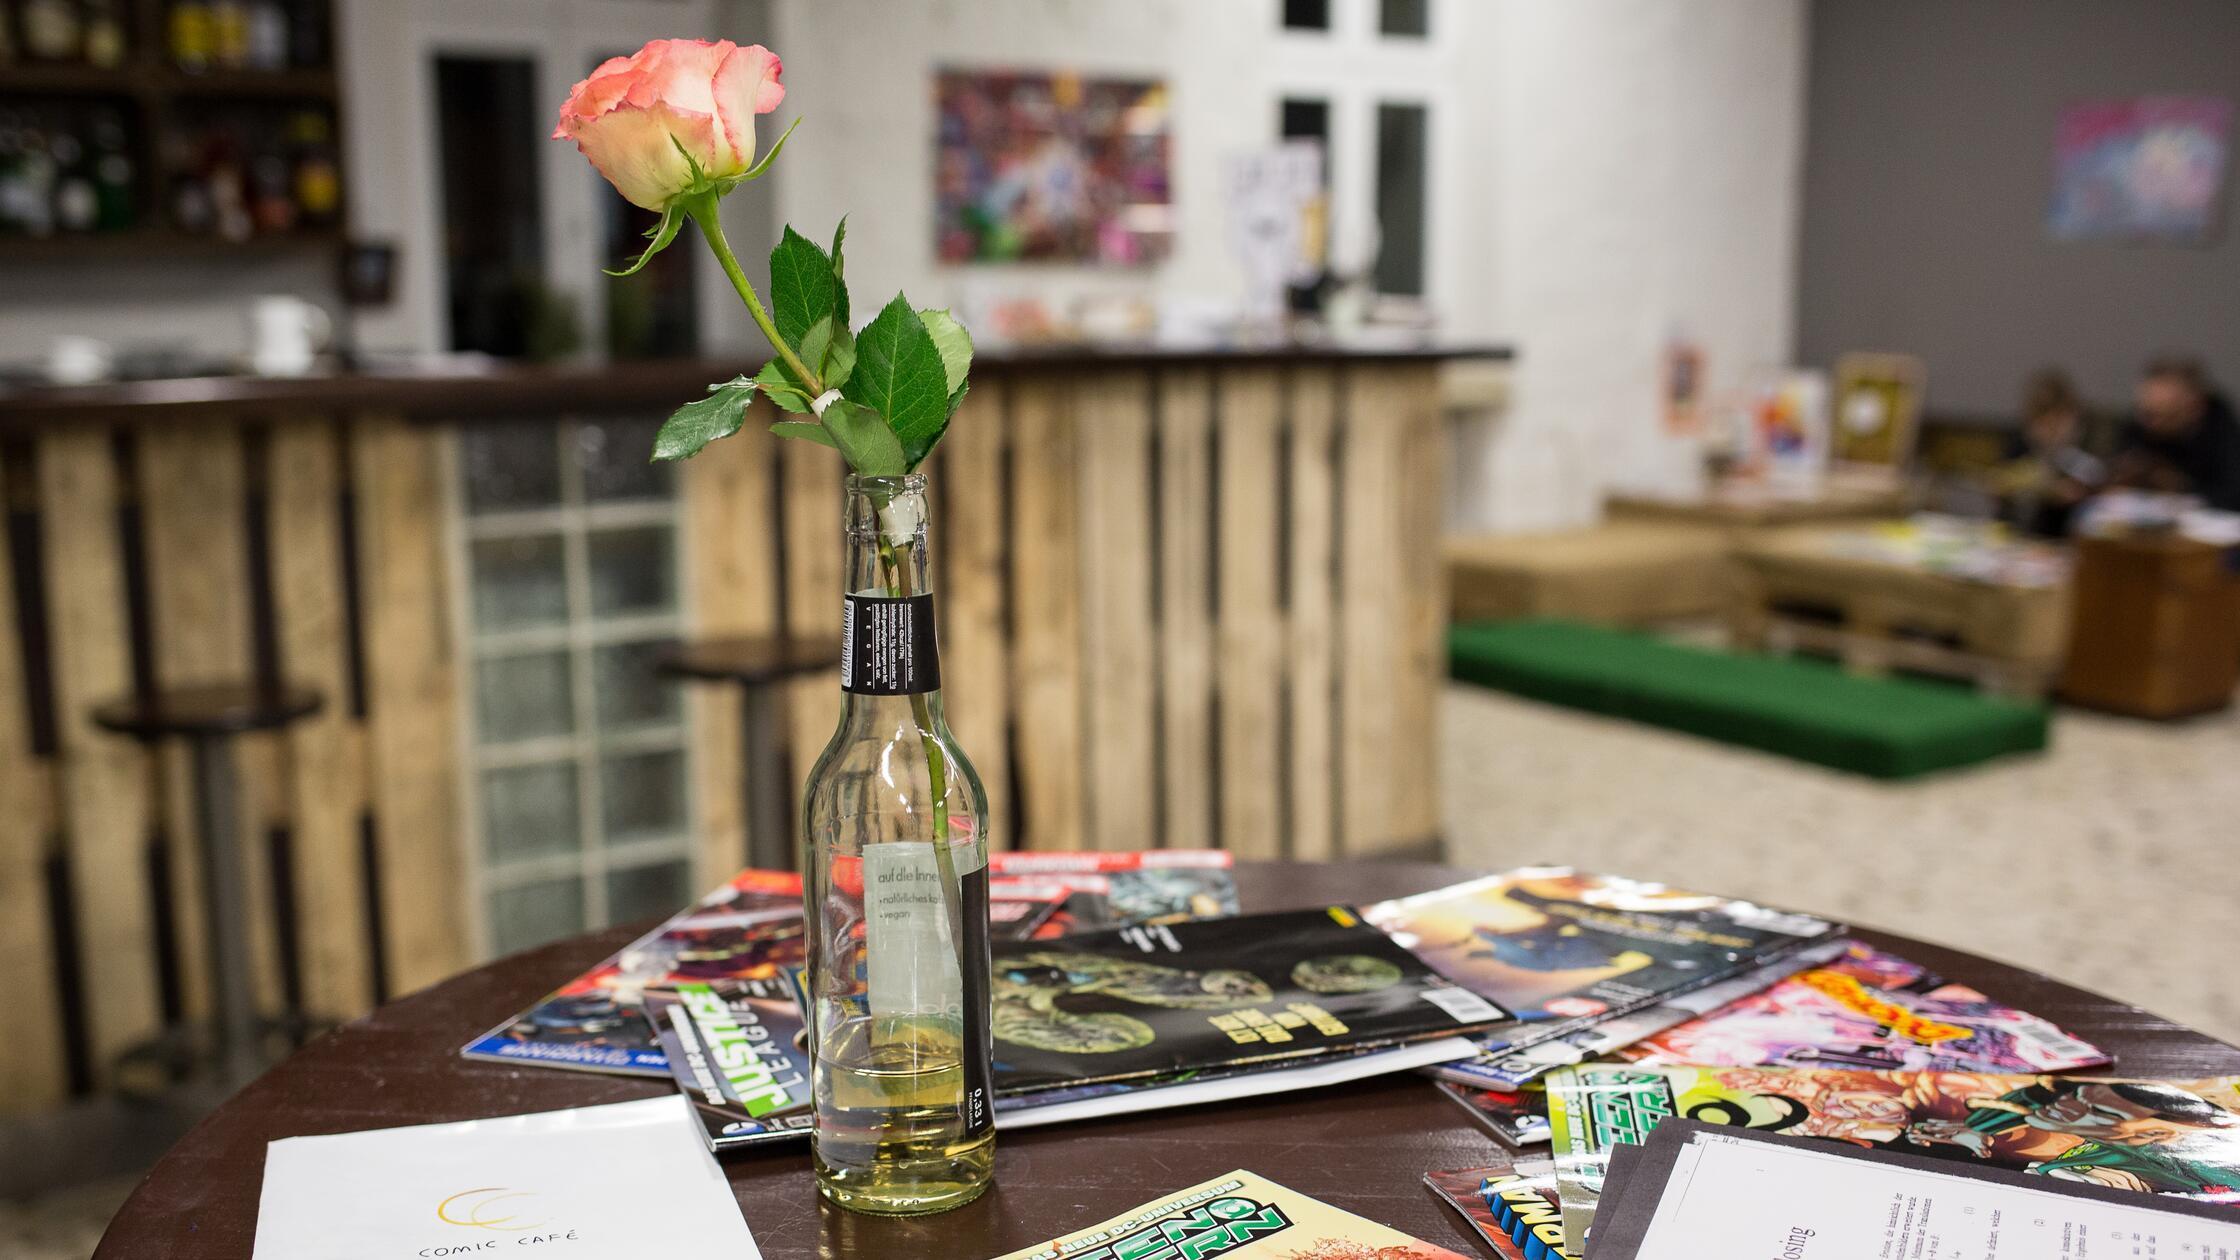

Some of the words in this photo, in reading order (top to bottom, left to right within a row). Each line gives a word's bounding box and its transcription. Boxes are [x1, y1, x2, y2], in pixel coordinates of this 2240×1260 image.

[878, 867, 894, 883] auf
[896, 866, 913, 882] die
[884, 911, 910, 920] vegan
[729, 1000, 805, 1090] LEAGUE
[973, 1087, 983, 1119] 0,33
[1061, 1232, 1110, 1255] NEUE
[1109, 1180, 1243, 1236] DC-UNIVERSUM
[418, 1239, 496, 1258] COMIC
[517, 1229, 579, 1246] CAFÉ
